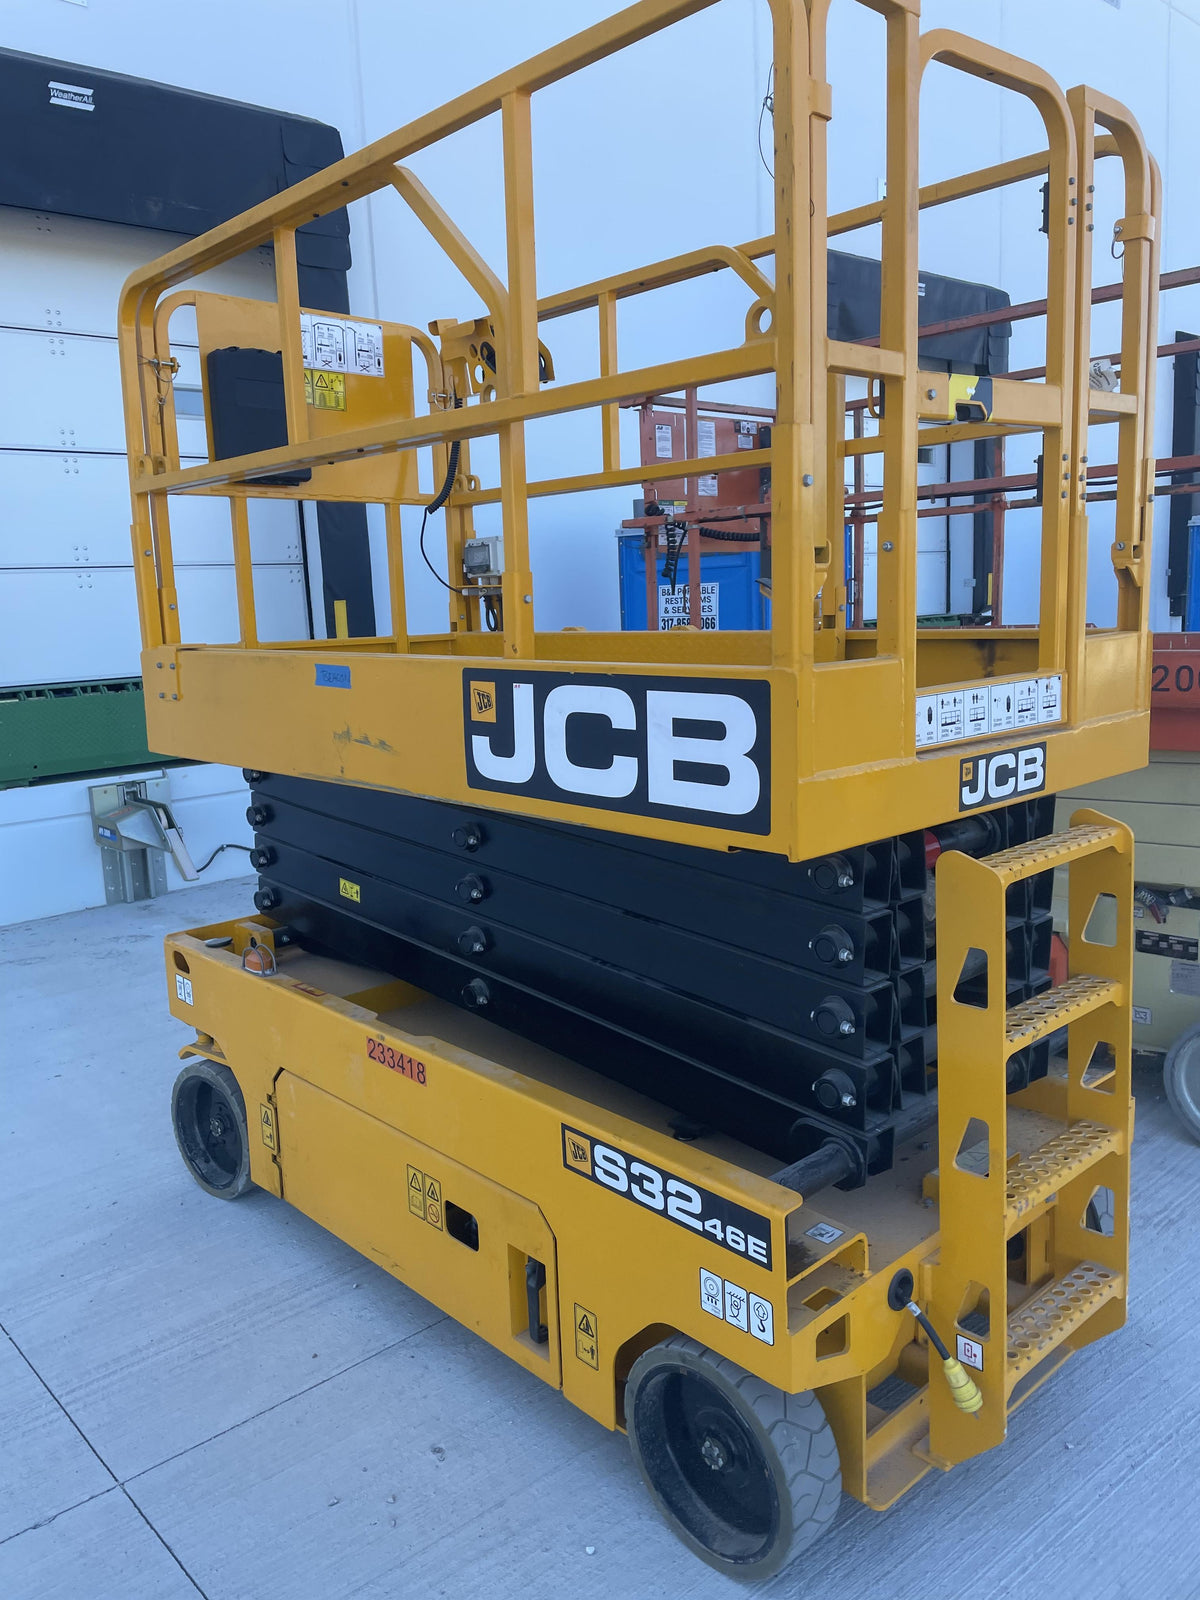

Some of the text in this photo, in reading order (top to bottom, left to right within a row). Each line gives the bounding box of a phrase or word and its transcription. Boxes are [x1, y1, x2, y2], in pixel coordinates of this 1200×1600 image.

[50, 88, 94, 104] WeatherAll
[661, 586, 716, 597] B& PBLE
[665, 595, 712, 604] RESTRMS
[664, 605, 713, 614] & SEES
[1151, 664, 1200, 692] 20
[477, 691, 492, 711] JCB
[471, 682, 761, 816] JCB
[962, 747, 1044, 806] JCB
[368, 1038, 426, 1084] 233418
